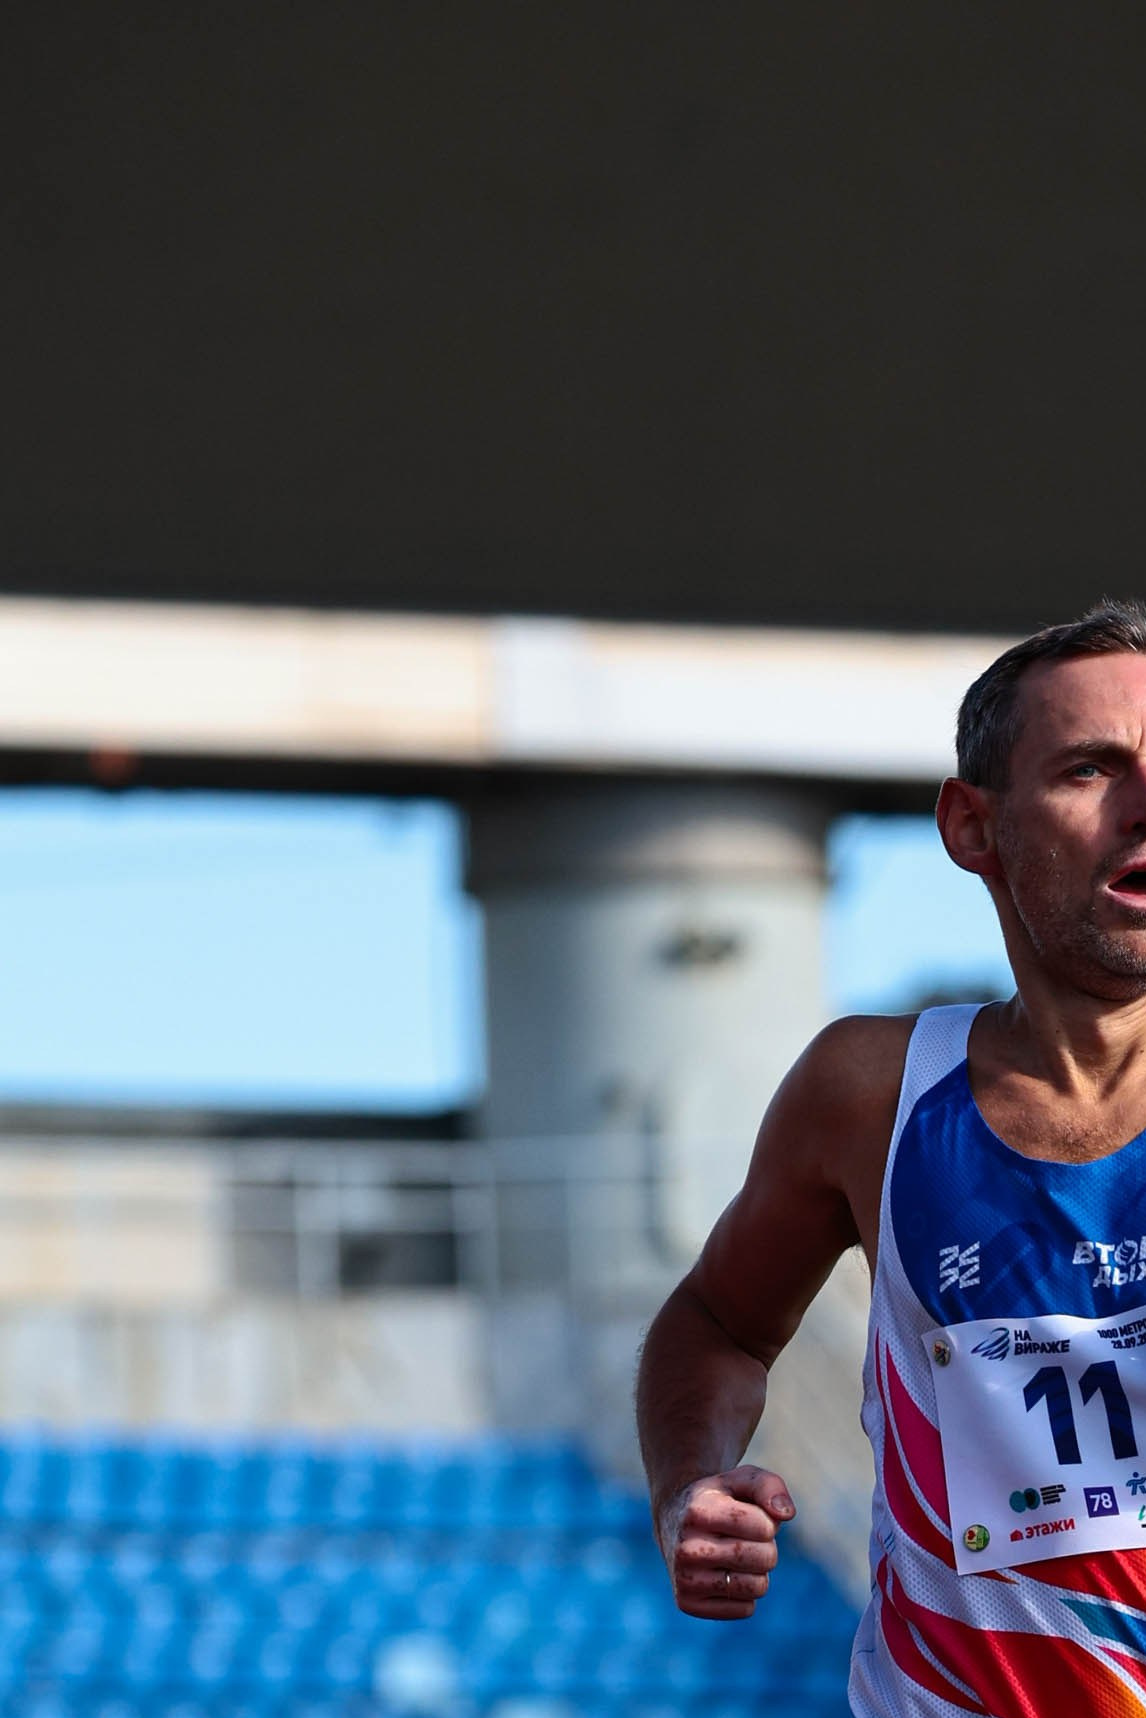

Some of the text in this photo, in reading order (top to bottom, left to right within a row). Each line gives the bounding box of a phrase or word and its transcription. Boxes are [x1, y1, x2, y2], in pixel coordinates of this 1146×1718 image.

[1013, 1329, 1032, 1342] НА
[1013, 1339, 1070, 1356] ВИРАЖЕ
[1023, 1360, 1138, 1465] 11
[1089, 1492, 1113, 1512] 78
